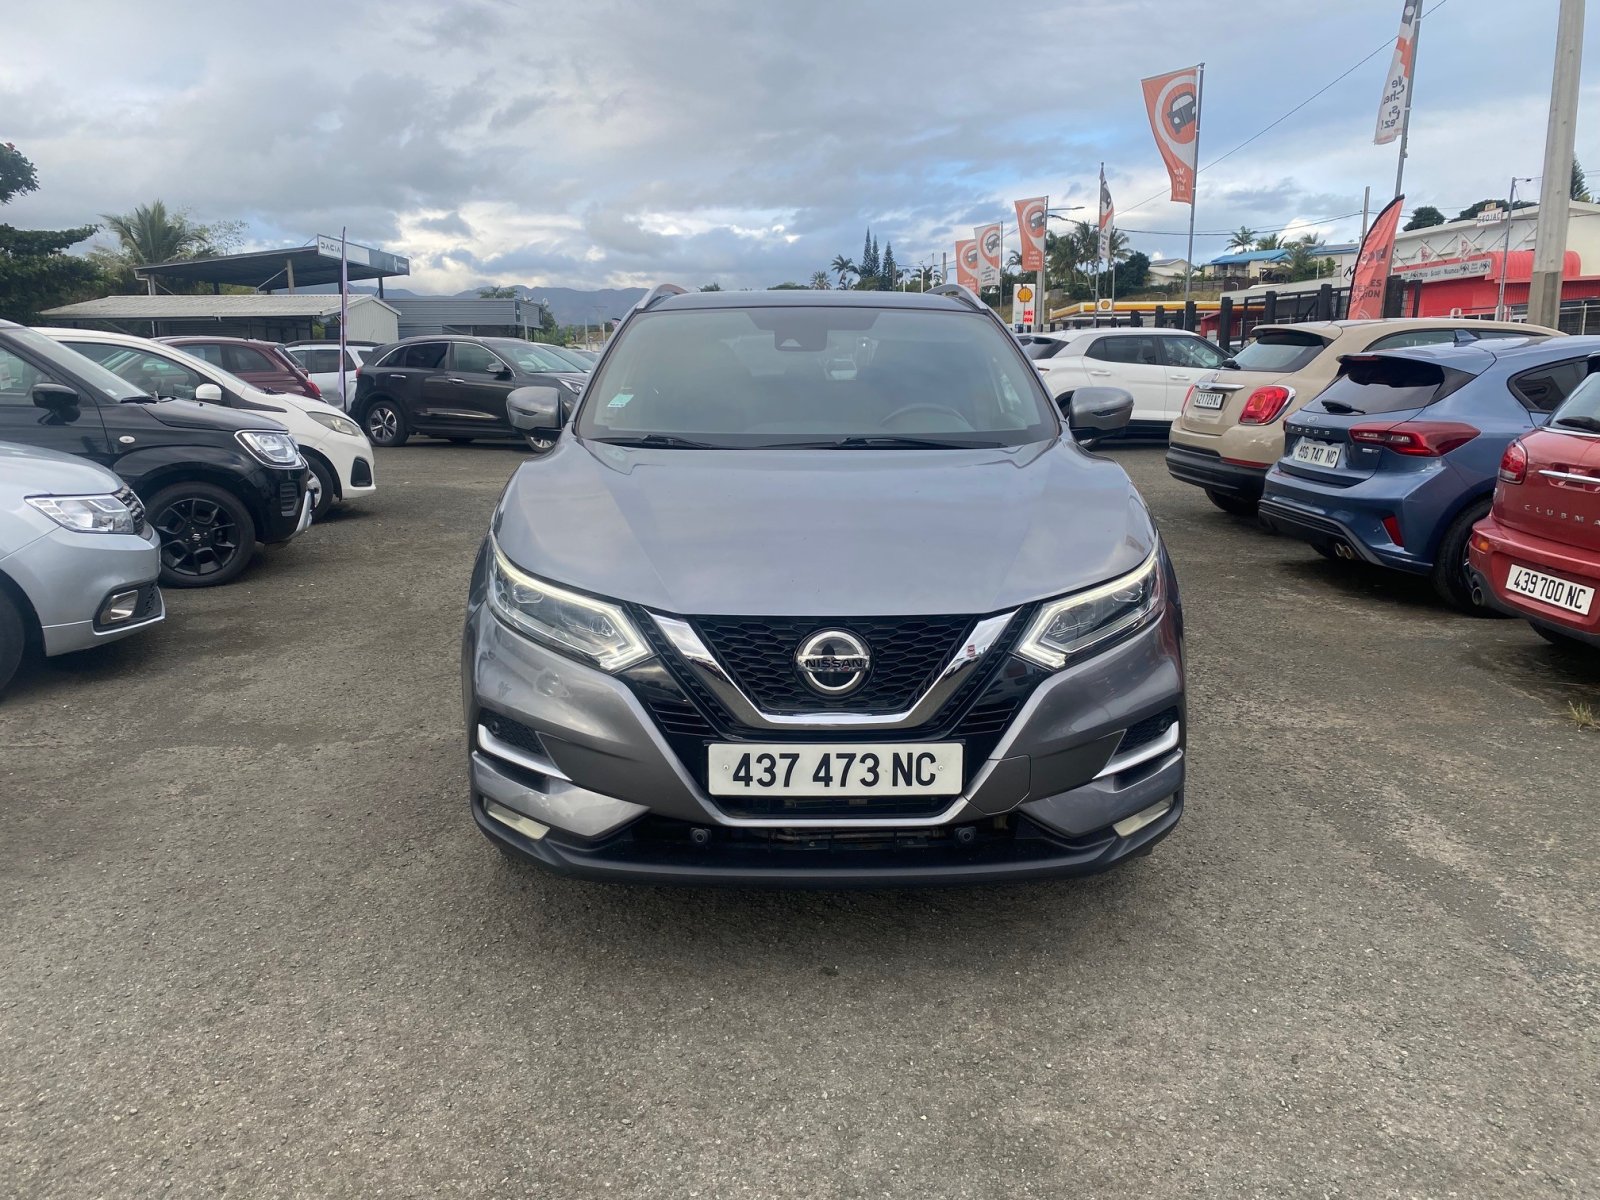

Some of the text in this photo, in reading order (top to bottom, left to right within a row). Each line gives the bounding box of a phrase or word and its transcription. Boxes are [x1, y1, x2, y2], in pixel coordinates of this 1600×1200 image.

[1291, 425, 1331, 436] FOCUS
[1513, 569, 1586, 609] 439 700 NC
[805, 658, 864, 668] NISSAN
[732, 752, 937, 788] 437 473 NC
